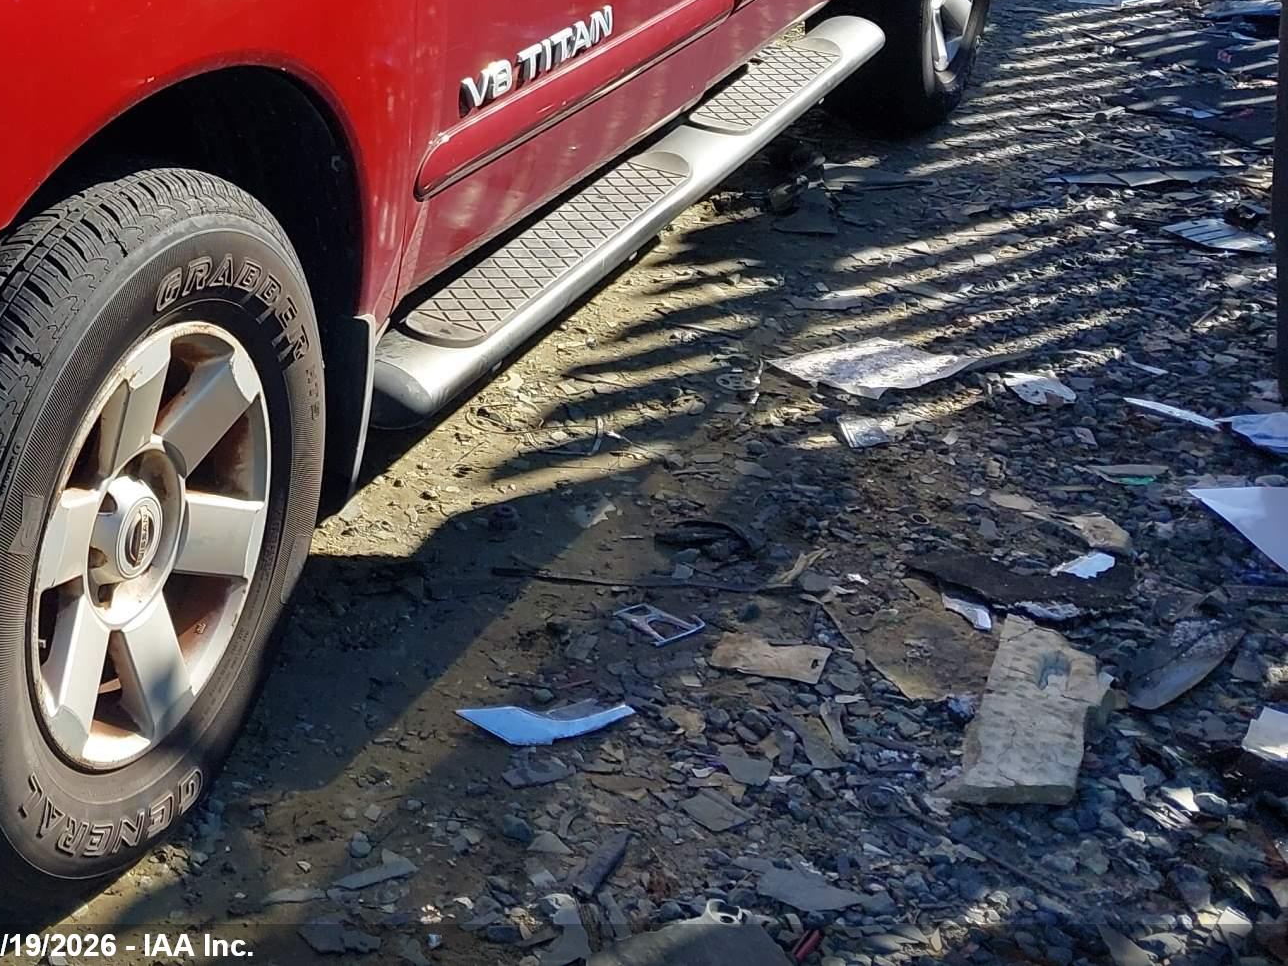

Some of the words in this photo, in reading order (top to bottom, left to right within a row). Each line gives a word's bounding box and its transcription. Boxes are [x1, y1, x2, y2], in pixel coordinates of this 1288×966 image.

[460, 59, 512, 107] V8
[517, 4, 613, 81] TITAN
[155, 253, 310, 362] GRABBER
[17, 766, 203, 857] GENERAL
